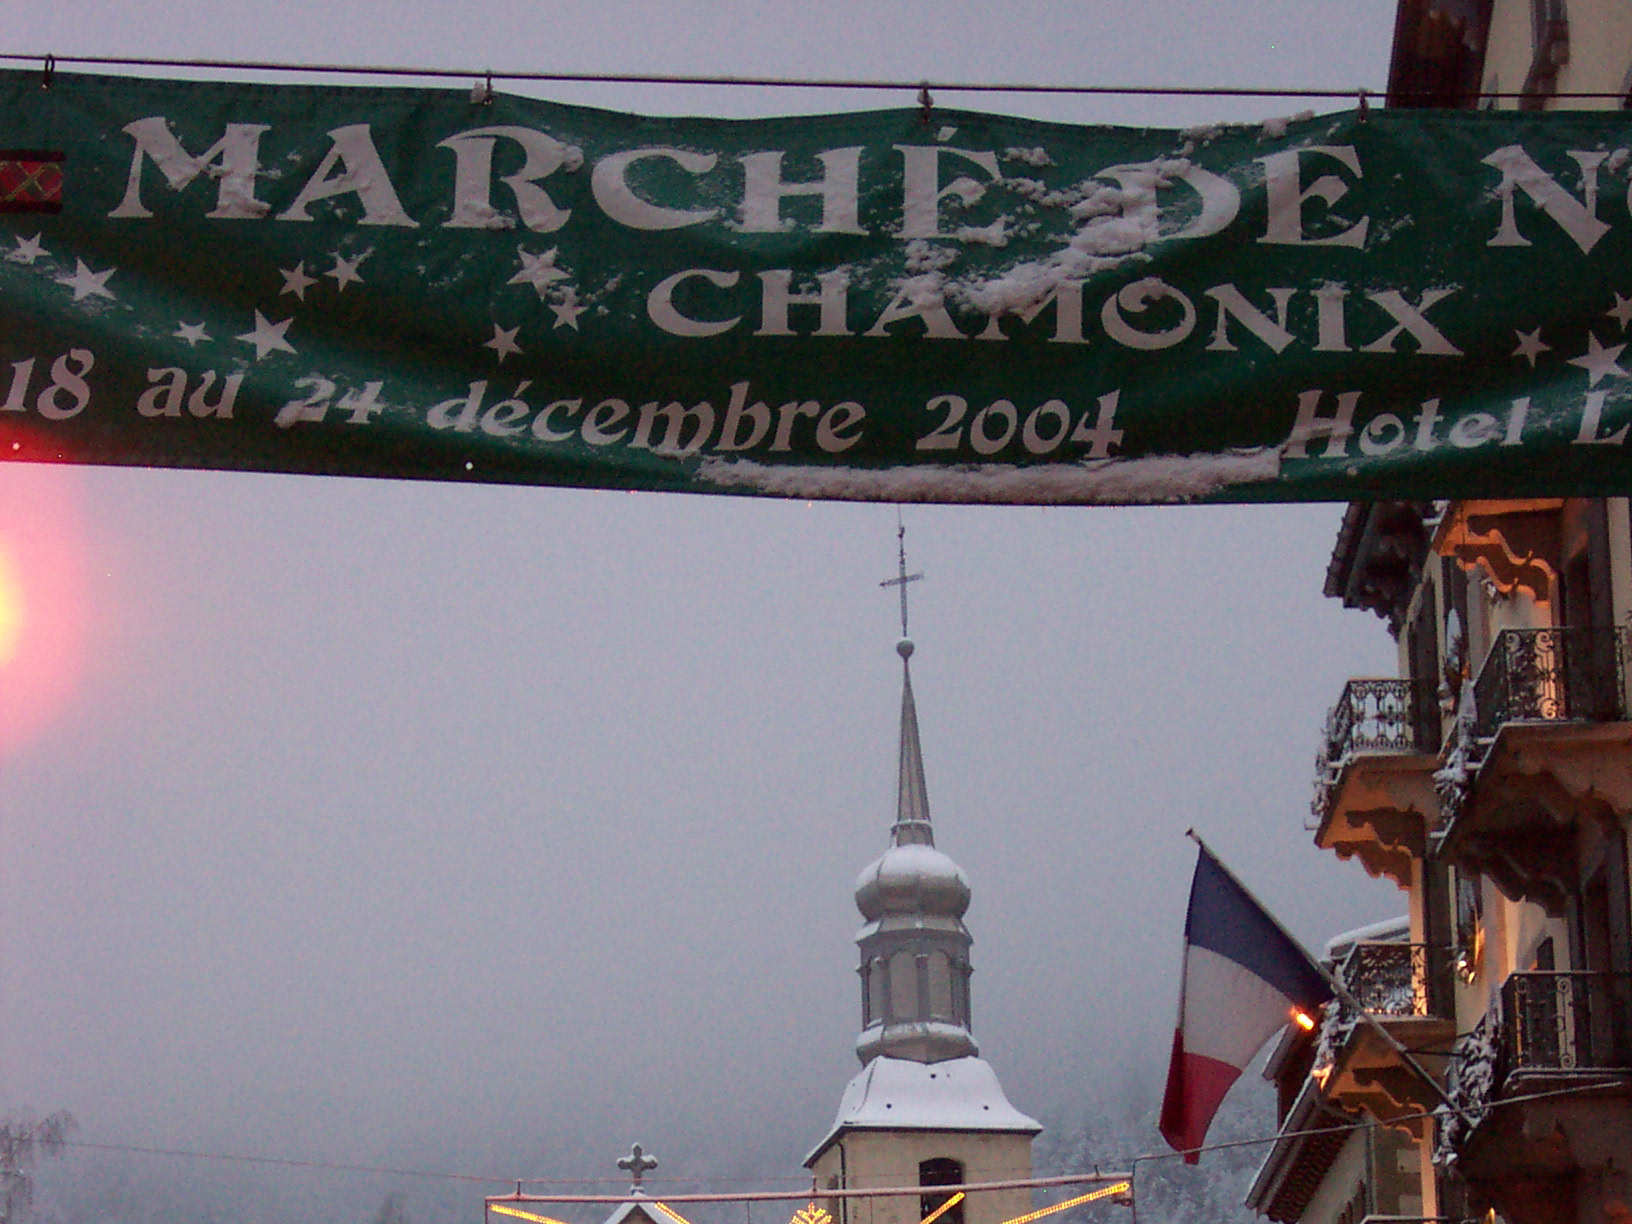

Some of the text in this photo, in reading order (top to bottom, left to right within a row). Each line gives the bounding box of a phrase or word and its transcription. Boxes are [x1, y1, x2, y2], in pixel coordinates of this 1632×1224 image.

[108, 116, 1632, 256] MARCHÉ DE N
[646, 267, 1464, 357] CHAMONIX
[0, 348, 1125, 457] 18 au 24 décembre 2004
[1284, 391, 1532, 458] Hotel
